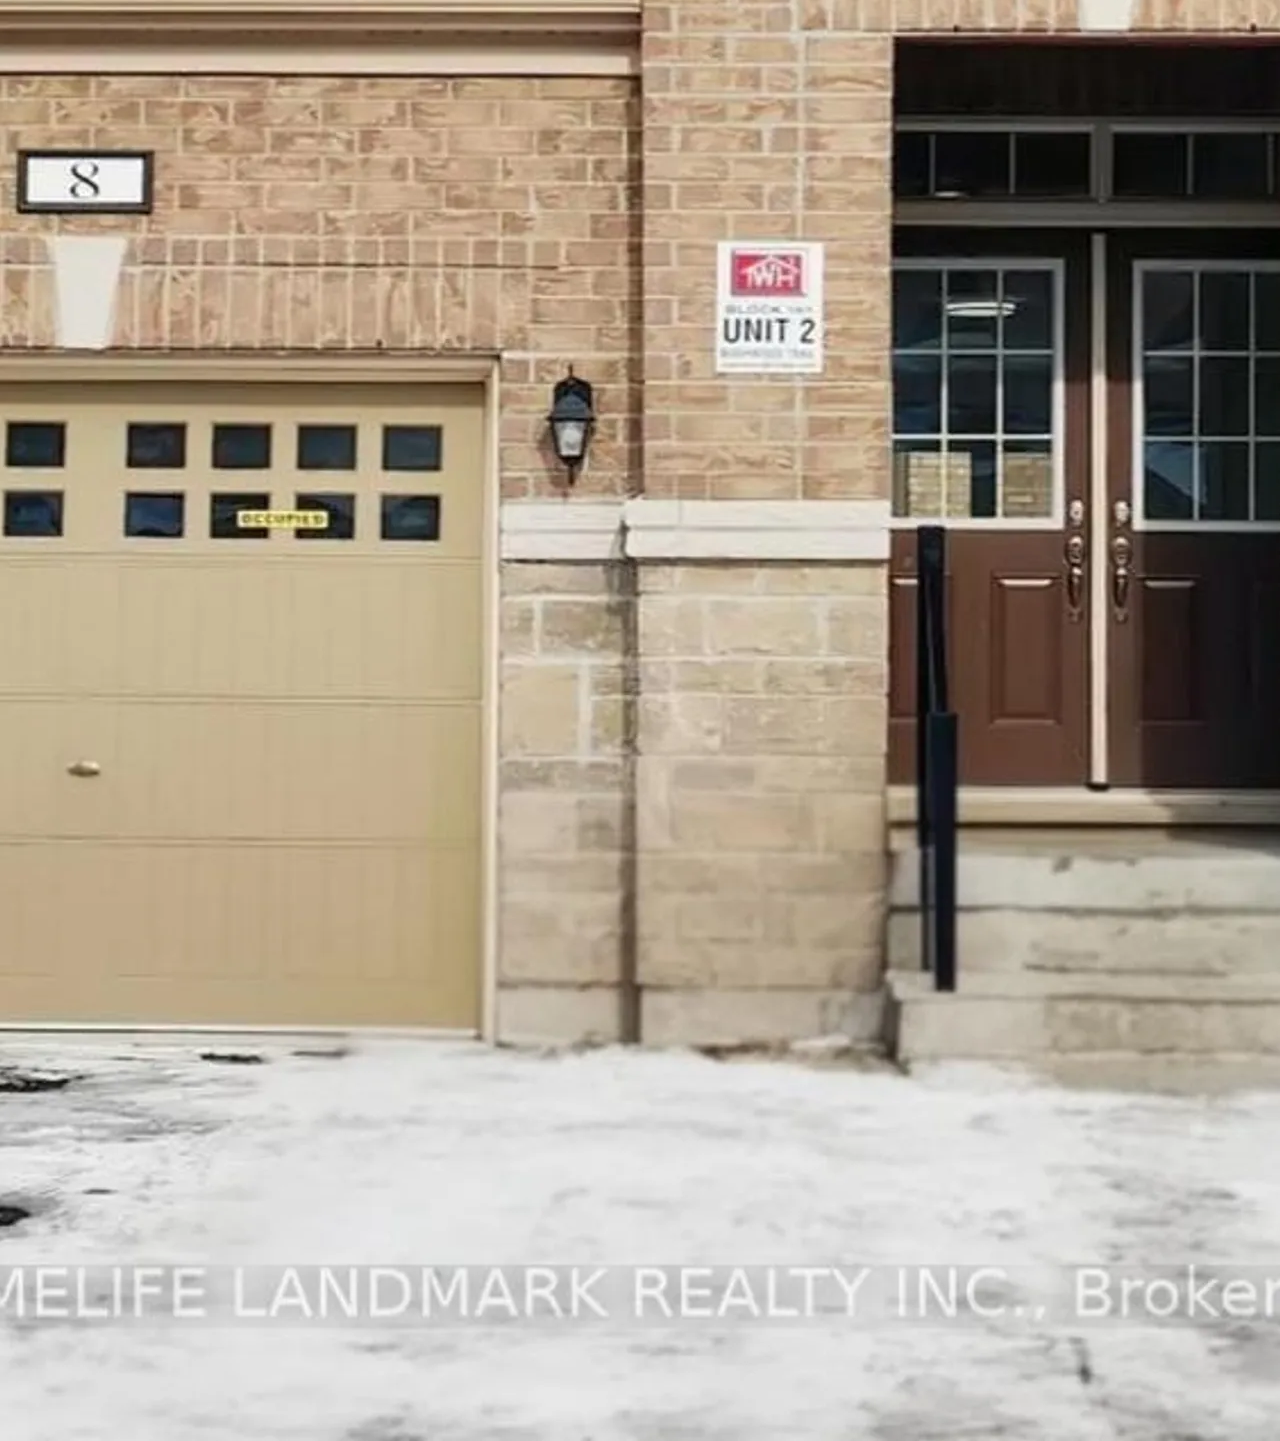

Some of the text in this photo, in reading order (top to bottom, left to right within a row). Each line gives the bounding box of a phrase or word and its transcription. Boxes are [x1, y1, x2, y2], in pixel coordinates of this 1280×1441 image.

[69, 161, 100, 199] 8
[723, 317, 817, 345] UNIT 2
